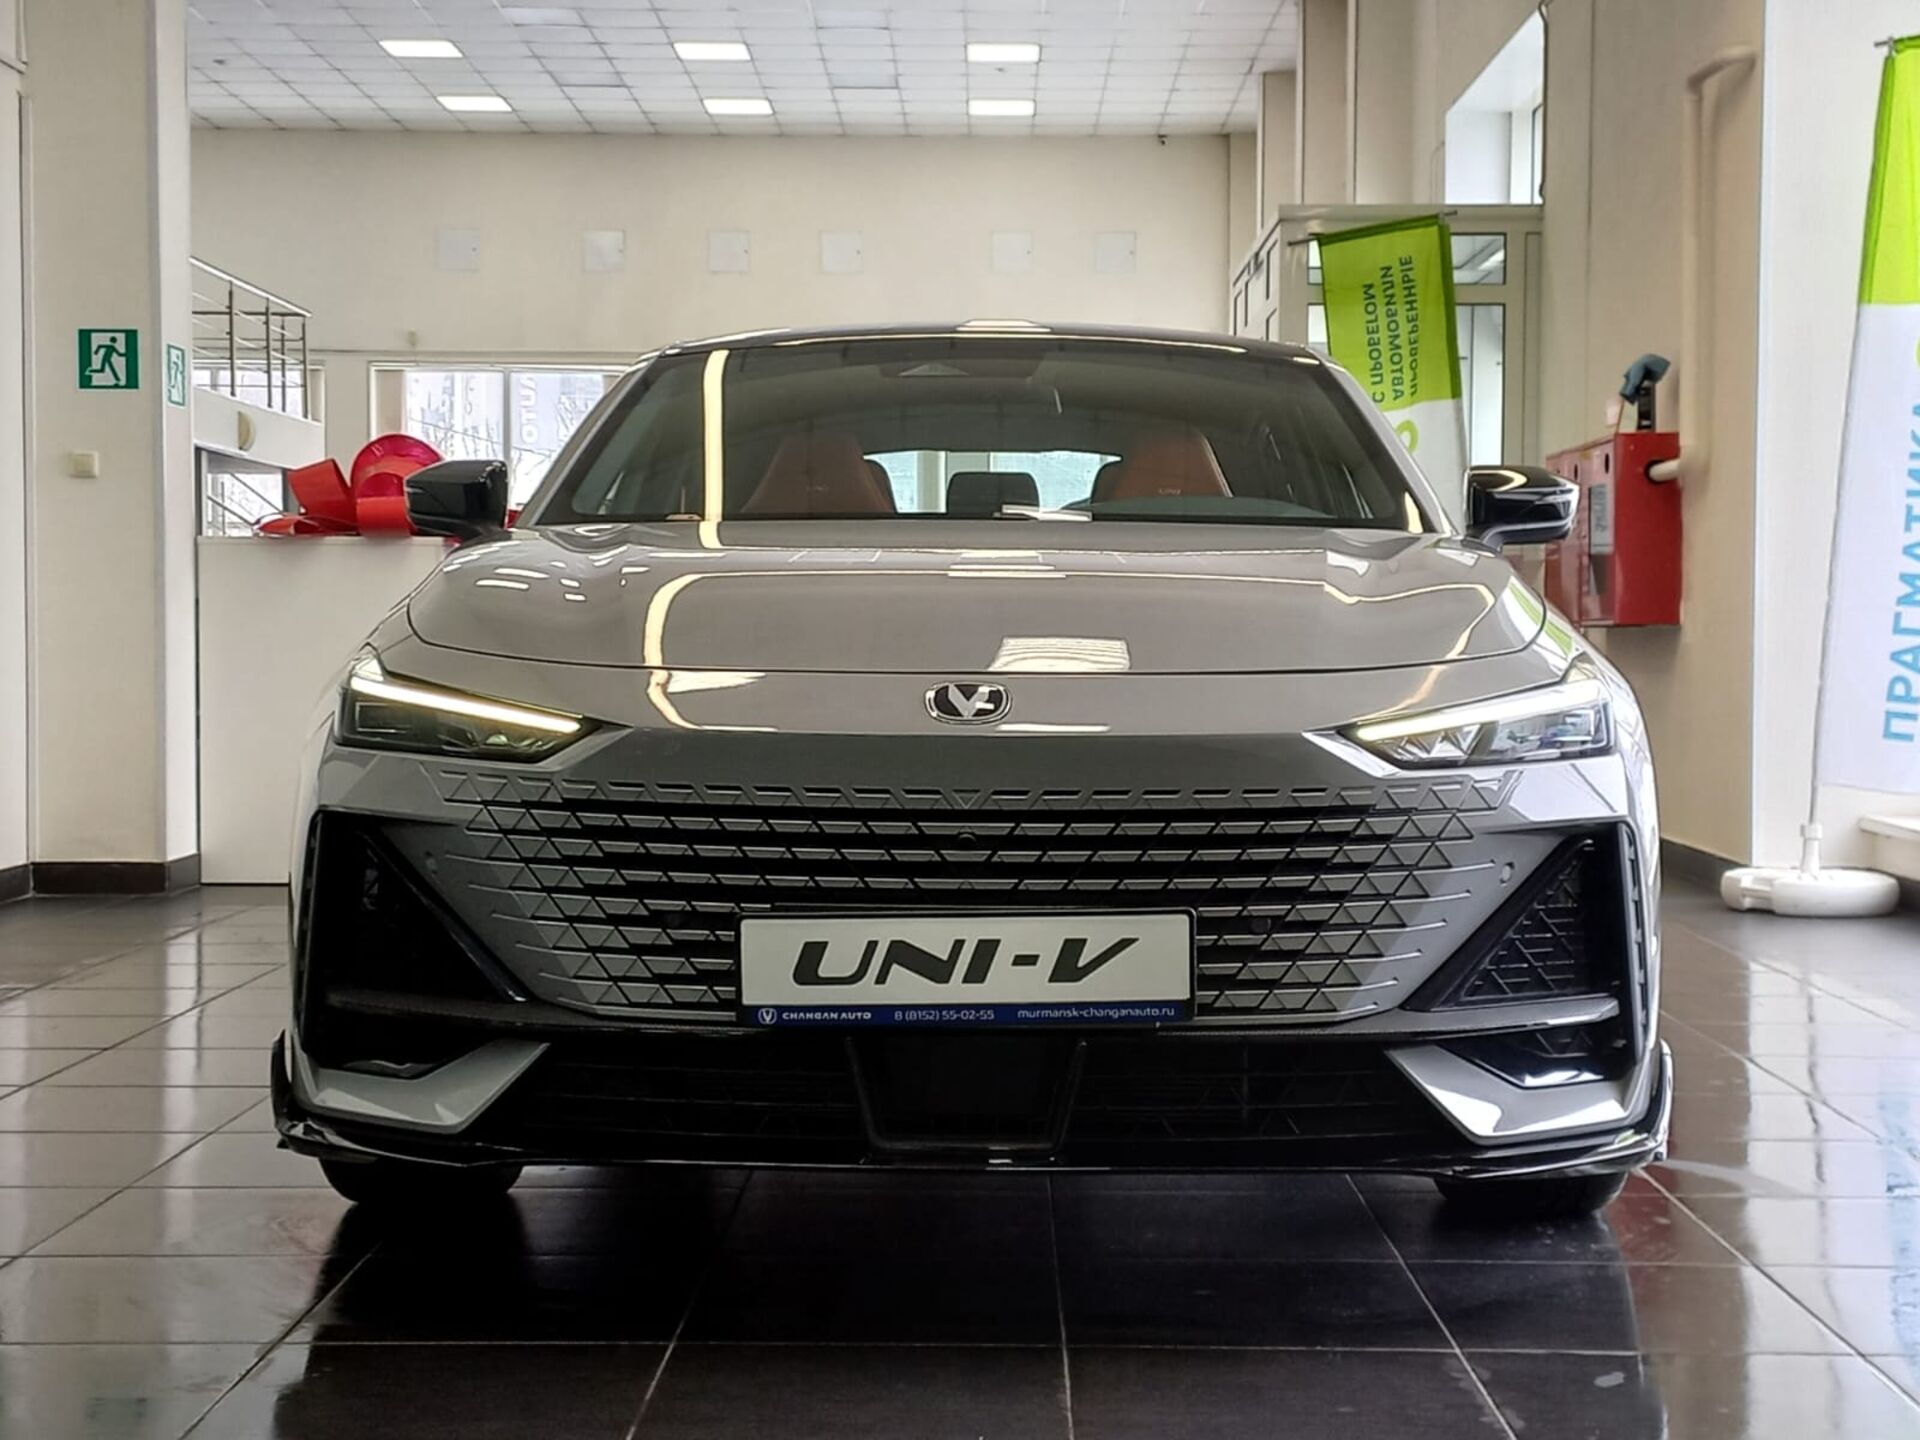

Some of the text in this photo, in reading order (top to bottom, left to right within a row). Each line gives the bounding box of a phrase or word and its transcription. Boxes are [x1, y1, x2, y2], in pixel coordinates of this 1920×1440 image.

[1883, 403, 1920, 742] ПРАГМАТ
[793, 938, 1139, 985] UNI-V
[782, 1007, 1175, 1022] CHANGAN AUTO 8 (8152) 55-02-55 murmansk-changanauto.ru
